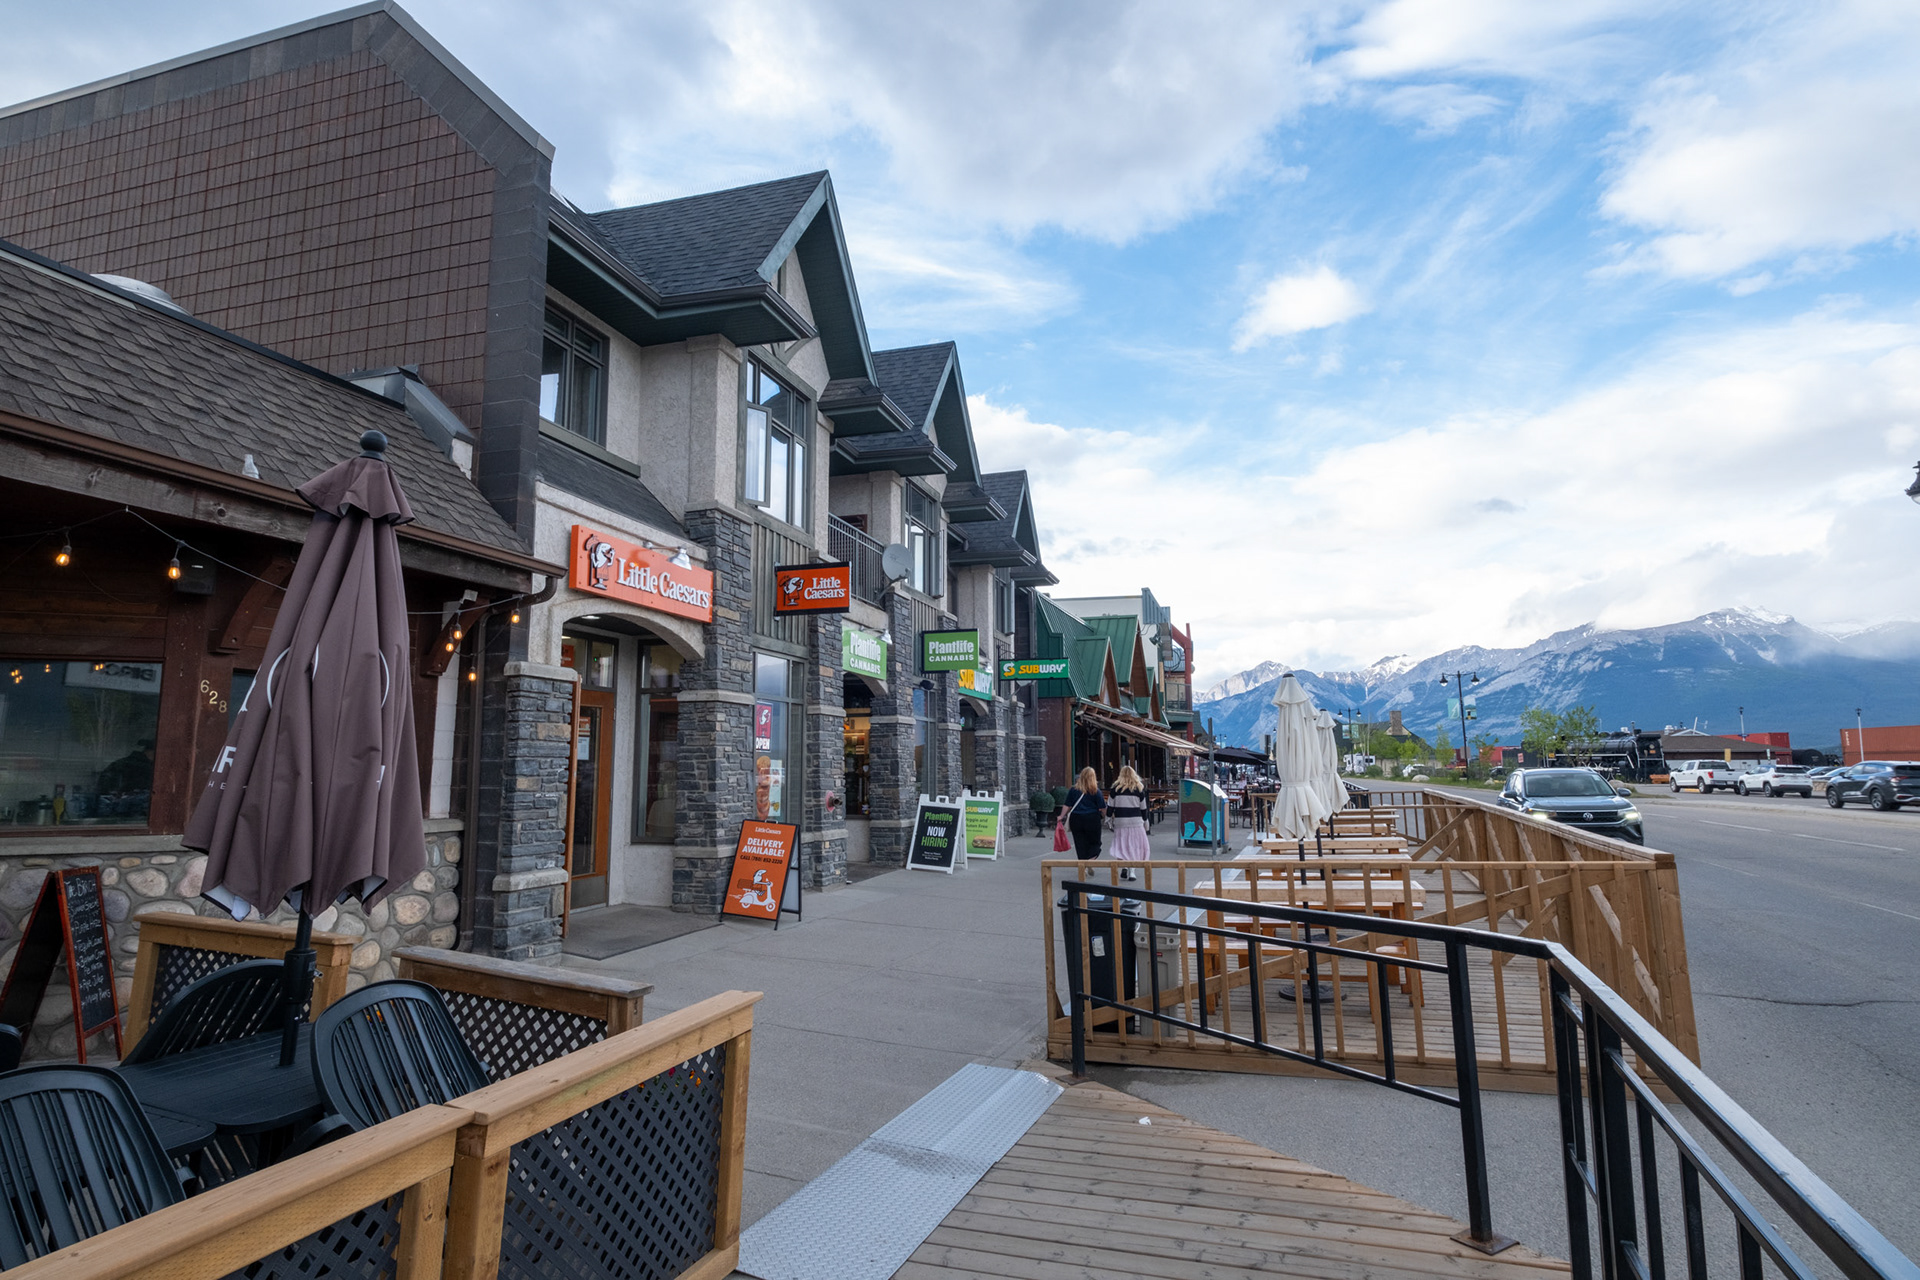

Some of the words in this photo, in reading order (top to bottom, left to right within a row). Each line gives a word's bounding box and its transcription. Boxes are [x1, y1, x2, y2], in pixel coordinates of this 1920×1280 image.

[617, 557, 657, 595] Little
[658, 571, 709, 609] Caesars
[812, 576, 841, 589] Little
[803, 587, 845, 600] Caesars
[850, 631, 881, 661] Plantlife
[928, 640, 974, 654] Plantlife
[928, 654, 975, 662] CANNABIS
[849, 658, 881, 675] CANNABIS
[1018, 664, 1064, 675] SUBWAY
[958, 669, 992, 694] SUBWAY
[199, 679, 228, 714] 628
[756, 737, 770, 751] OPEN
[924, 812, 953, 822] Plantlife
[927, 826, 946, 837] NOW
[747, 837, 784, 848] DELIVERY
[921, 836, 948, 848] HIRING
[742, 845, 785, 857] AVAILABLE!
